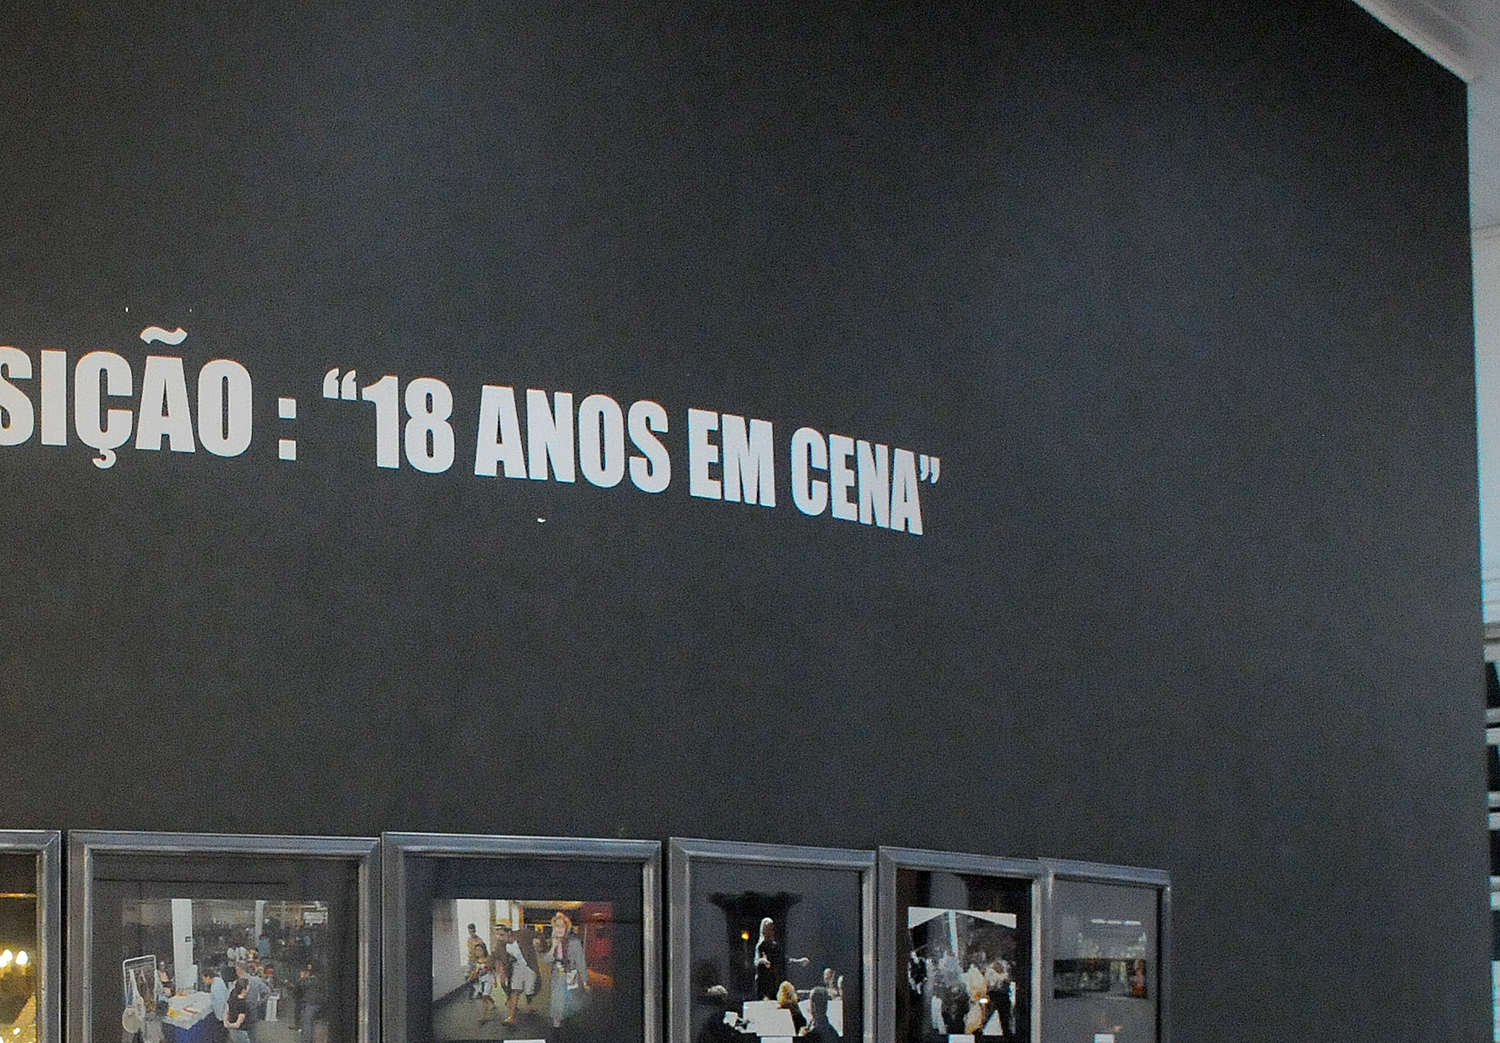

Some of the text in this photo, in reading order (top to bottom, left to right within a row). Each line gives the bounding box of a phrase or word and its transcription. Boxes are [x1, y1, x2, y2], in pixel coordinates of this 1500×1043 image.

[322, 367, 455, 474] “18
[473, 384, 672, 494] ANOS
[687, 407, 777, 508] EM
[790, 426, 941, 536] CENA”
